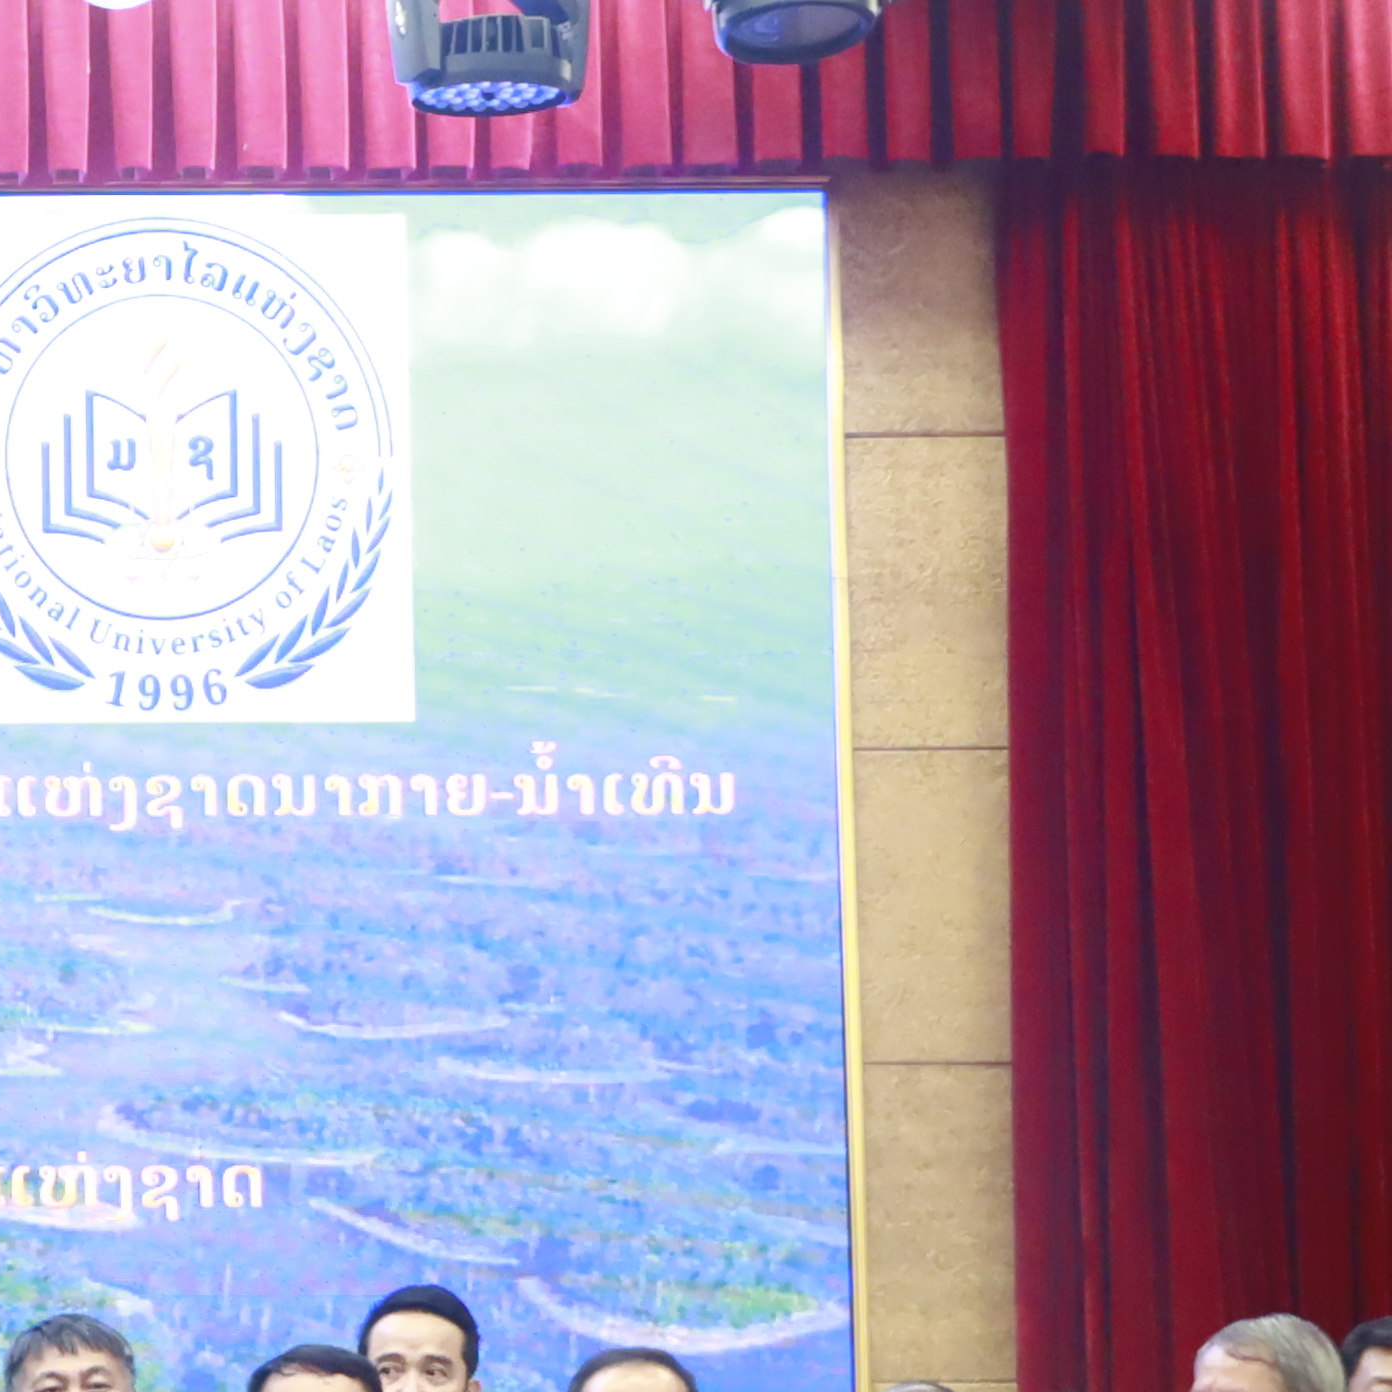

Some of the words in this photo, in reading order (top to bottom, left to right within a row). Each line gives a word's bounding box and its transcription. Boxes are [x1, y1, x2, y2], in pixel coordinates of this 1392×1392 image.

[88, 608, 267, 656] University
[274, 577, 307, 611] of
[311, 495, 349, 574] Laos
[106, 668, 229, 711] 1996
